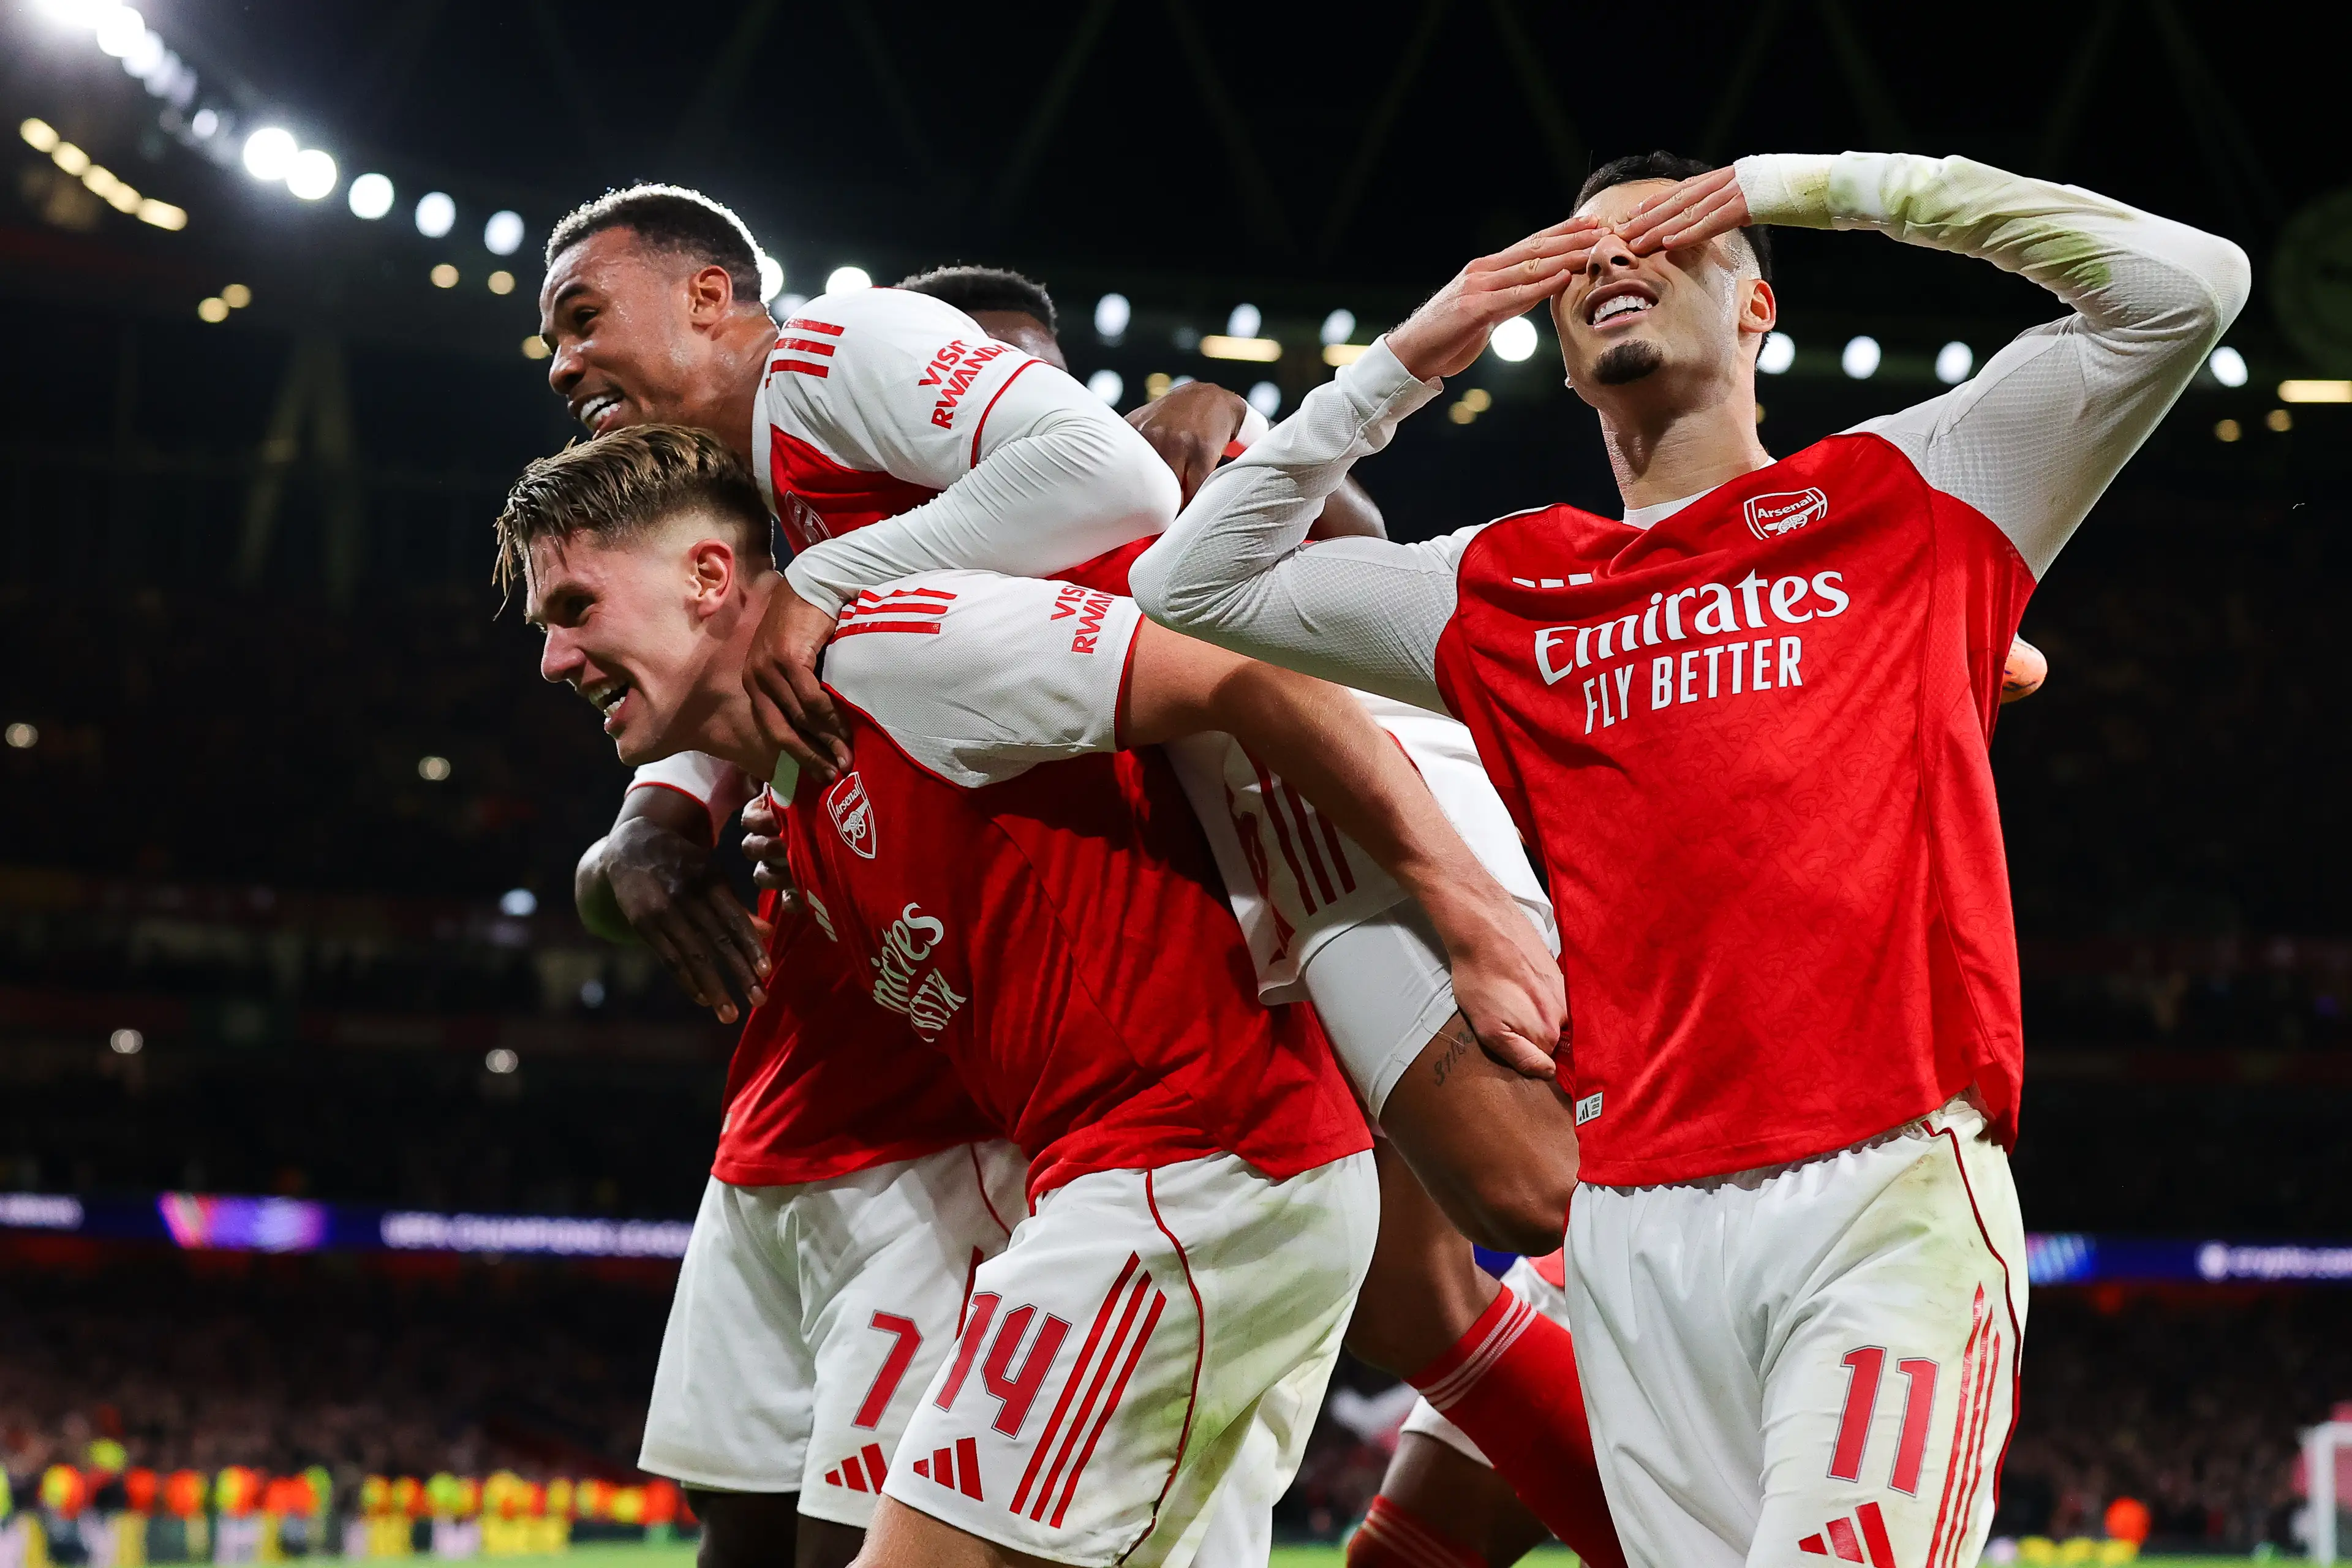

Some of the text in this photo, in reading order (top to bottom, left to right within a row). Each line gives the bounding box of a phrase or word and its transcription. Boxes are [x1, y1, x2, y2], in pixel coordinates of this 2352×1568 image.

[1757, 495, 1814, 518] Arsenal
[1533, 567, 1850, 686] Emirates
[1583, 635, 1804, 735] FLY BETTER
[835, 783, 861, 818] Arsenal
[850, 1310, 924, 1431] 7
[933, 1291, 1073, 1439] 14
[1826, 1345, 1940, 1498] 11
